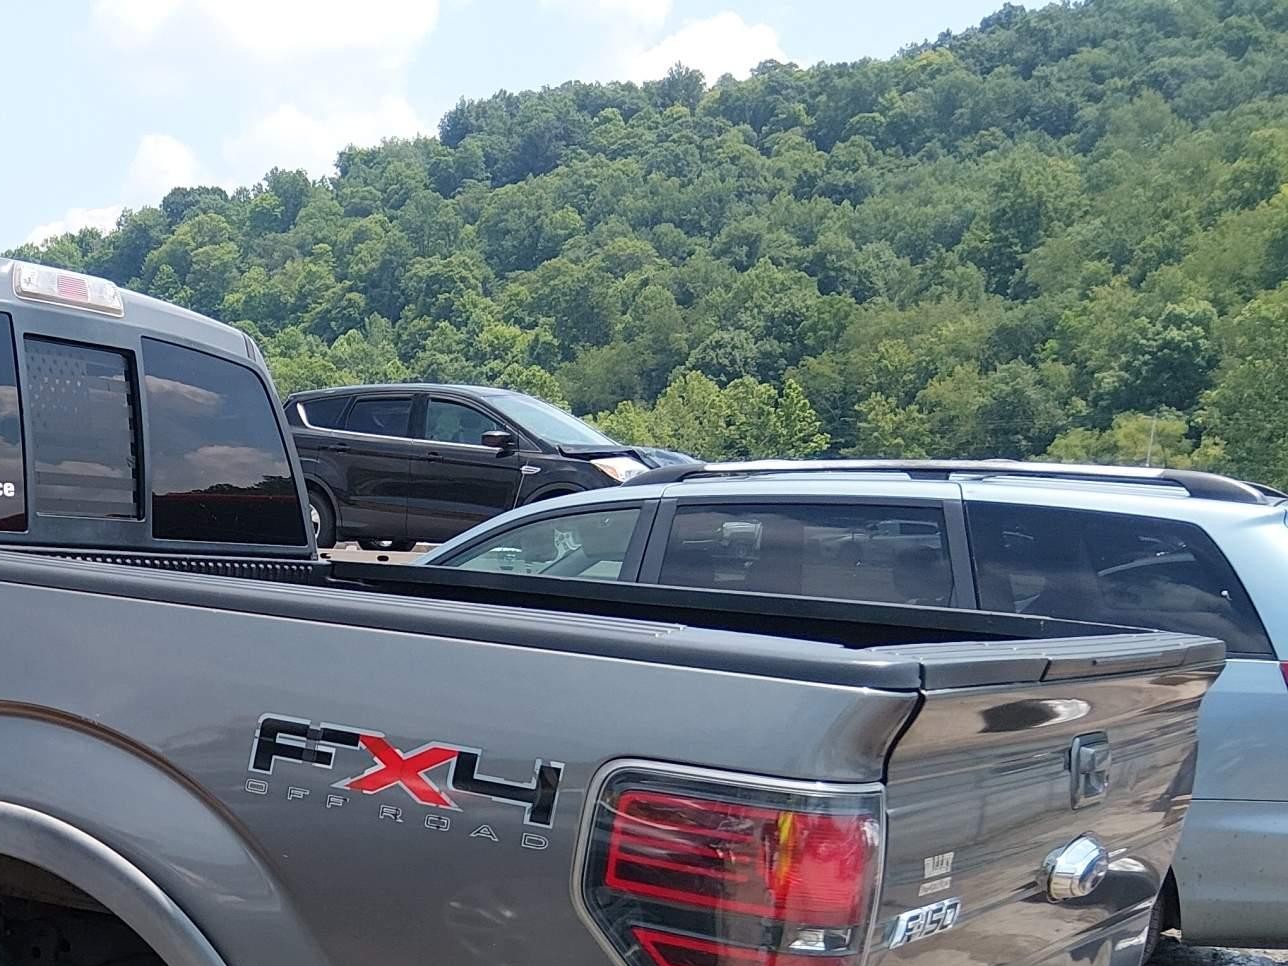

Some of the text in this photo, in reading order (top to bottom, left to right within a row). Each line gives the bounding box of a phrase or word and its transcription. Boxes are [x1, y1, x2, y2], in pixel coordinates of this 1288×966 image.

[245, 778, 550, 851] OFF ROAD
[248, 712, 565, 828] FX4
